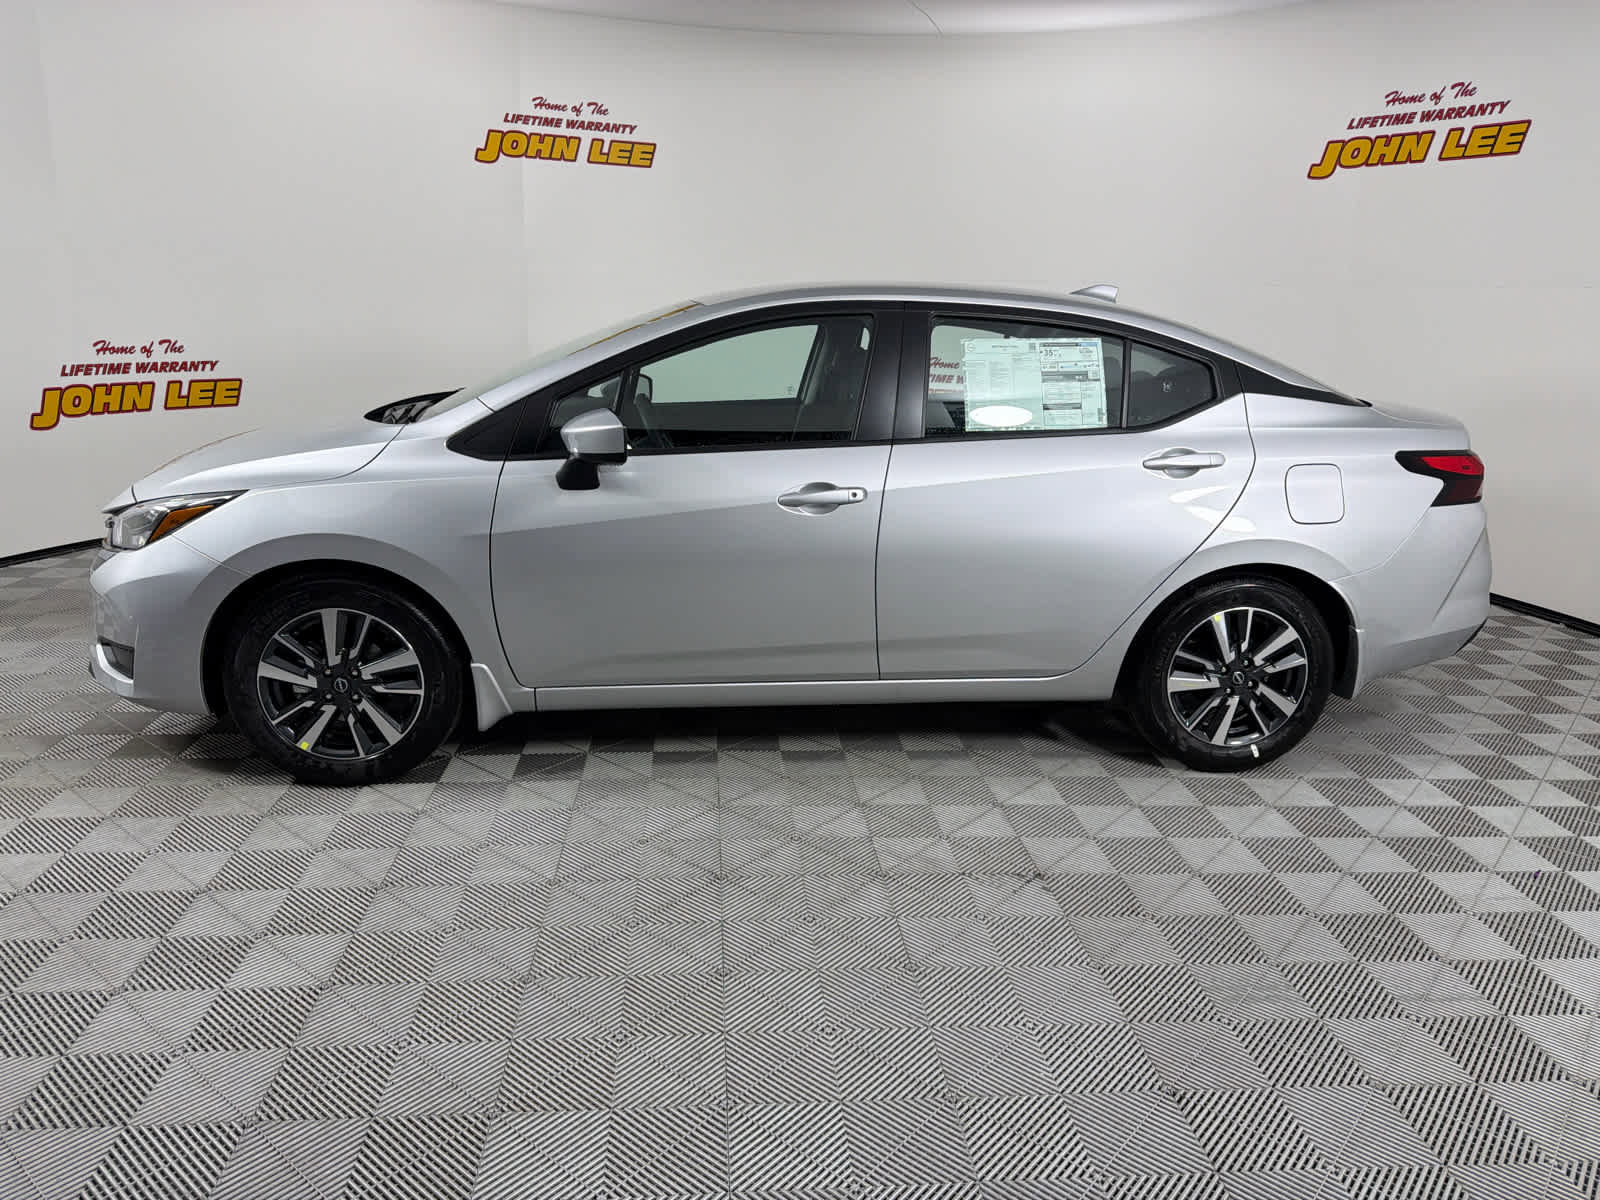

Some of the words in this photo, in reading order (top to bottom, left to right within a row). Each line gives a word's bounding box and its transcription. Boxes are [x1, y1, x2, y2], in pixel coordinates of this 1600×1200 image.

[1384, 90, 1426, 107] Home
[1430, 86, 1447, 105] of
[1450, 81, 1477, 98] The
[532, 96, 568, 112] Home
[571, 101, 583, 117] of
[587, 102, 609, 116] The
[1346, 111, 1417, 130] LIFETIME
[1420, 100, 1511, 123] WARRANTY
[503, 112, 563, 128] LIFETIME
[566, 118, 638, 135] WARRANTY
[474, 129, 582, 164] JOHN
[587, 138, 657, 168] LEE
[1307, 130, 1436, 180] JOHN
[1438, 119, 1532, 161] LEE
[92, 339, 136, 356] Home
[140, 341, 155, 358] of
[158, 339, 185, 355] The
[60, 362, 132, 377] LIFETIME
[135, 360, 219, 375] WARRANTY
[929, 357, 960, 369] Home
[29, 381, 155, 431] JOHN
[164, 378, 243, 410] LEE
